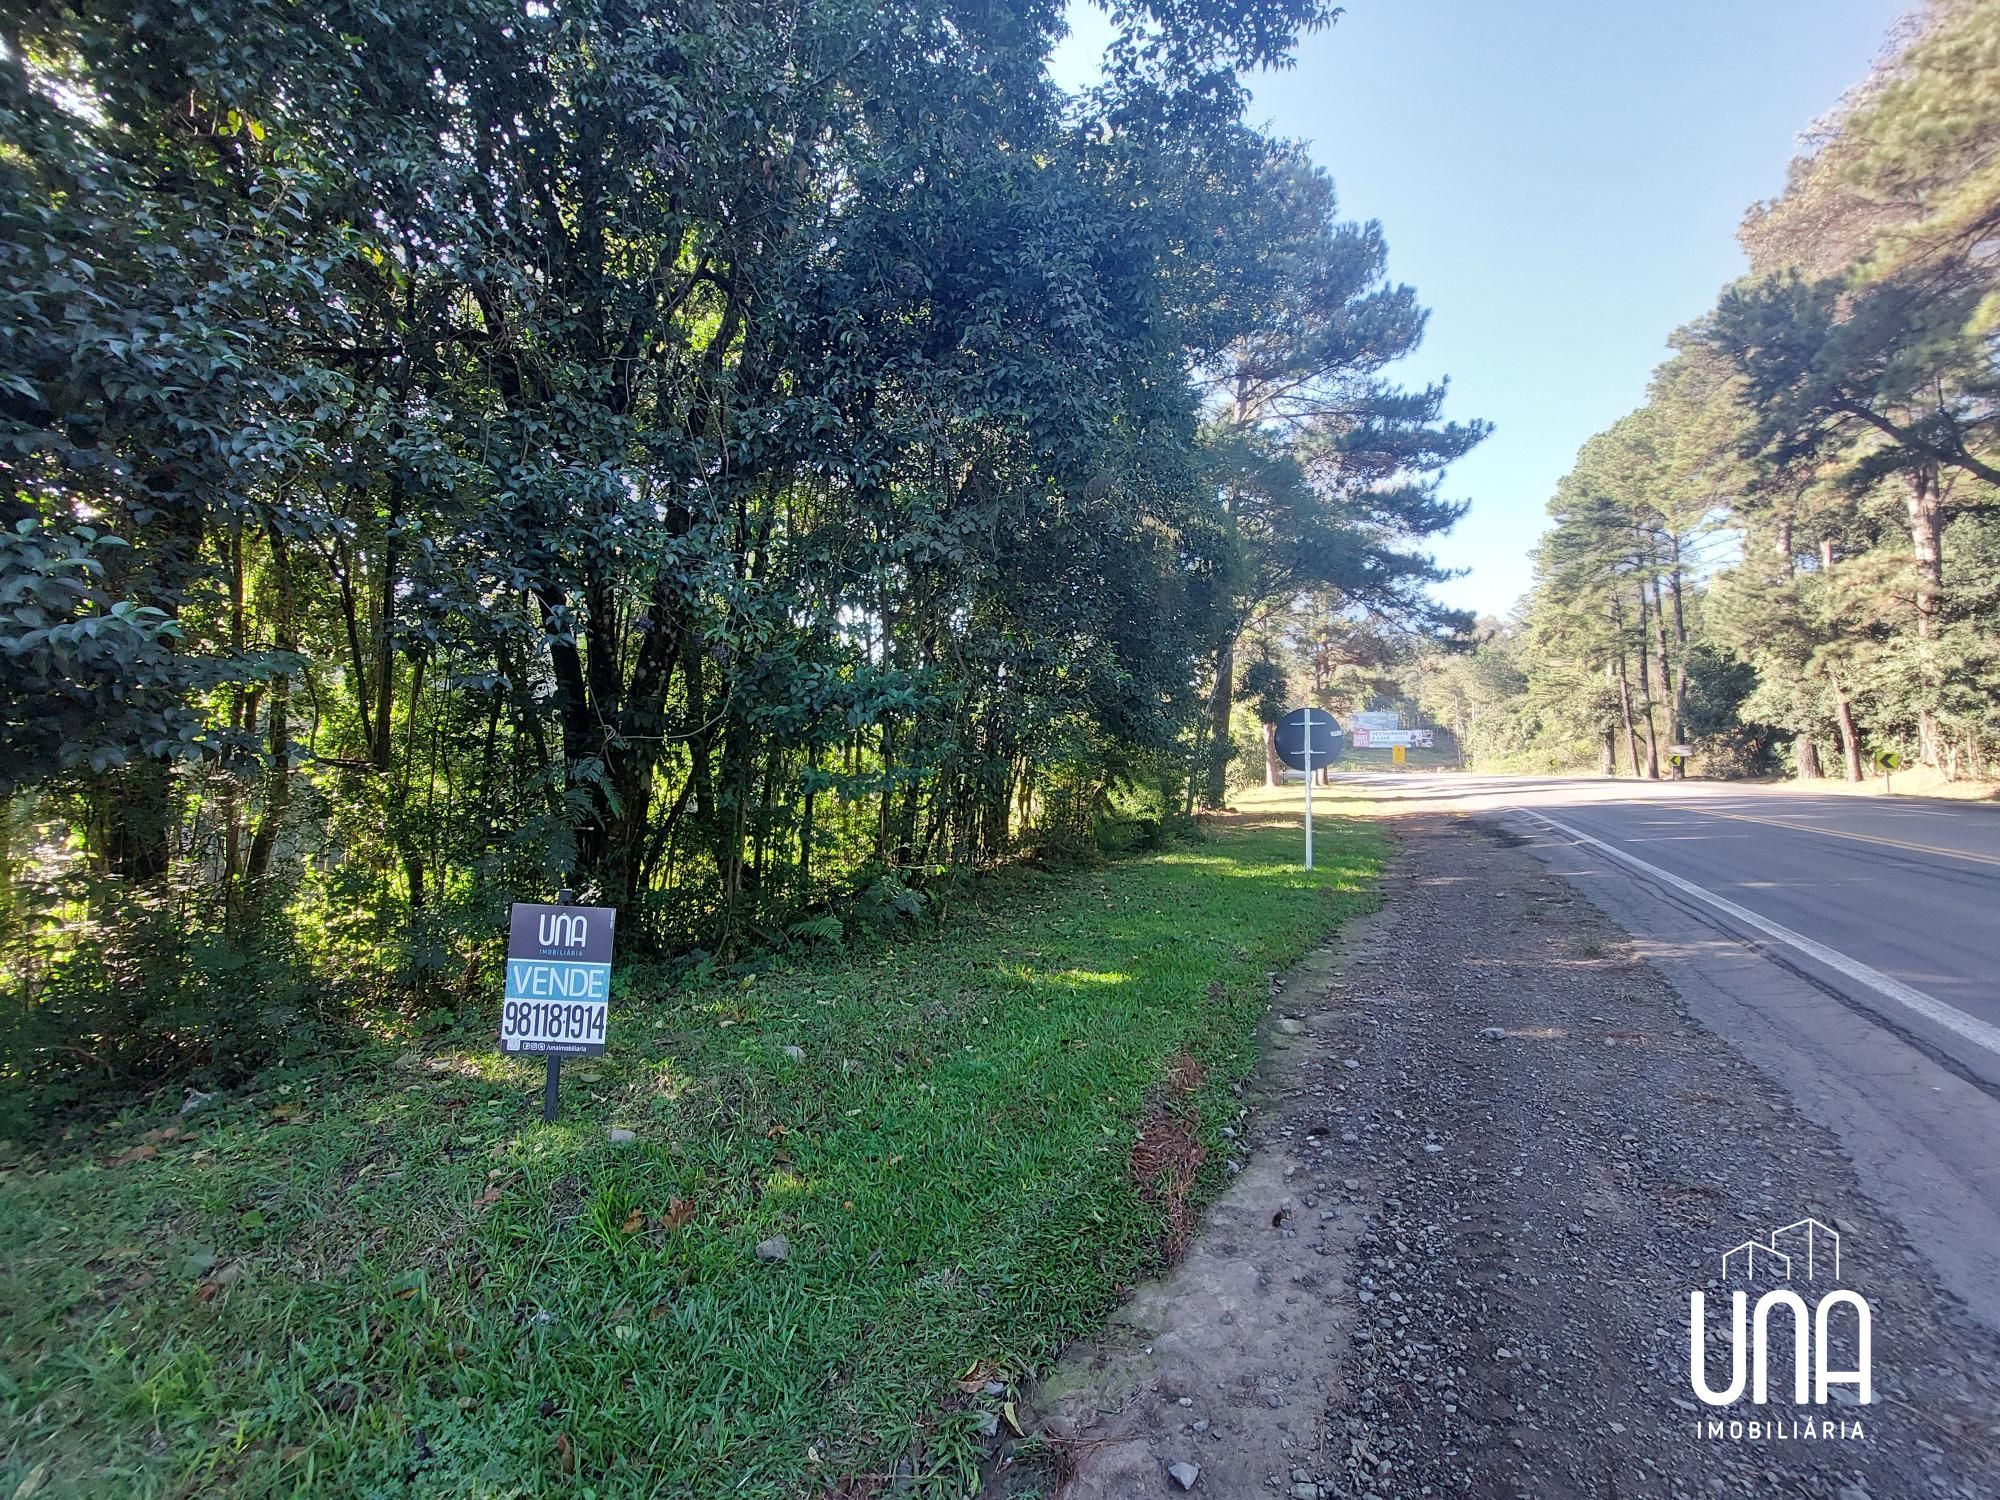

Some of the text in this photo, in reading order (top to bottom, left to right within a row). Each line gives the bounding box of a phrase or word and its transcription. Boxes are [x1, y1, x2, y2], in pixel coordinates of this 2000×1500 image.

[538, 913, 588, 948] UNA
[539, 948, 583, 957] IMOBILIÁRIA
[513, 965, 605, 998] VENDE
